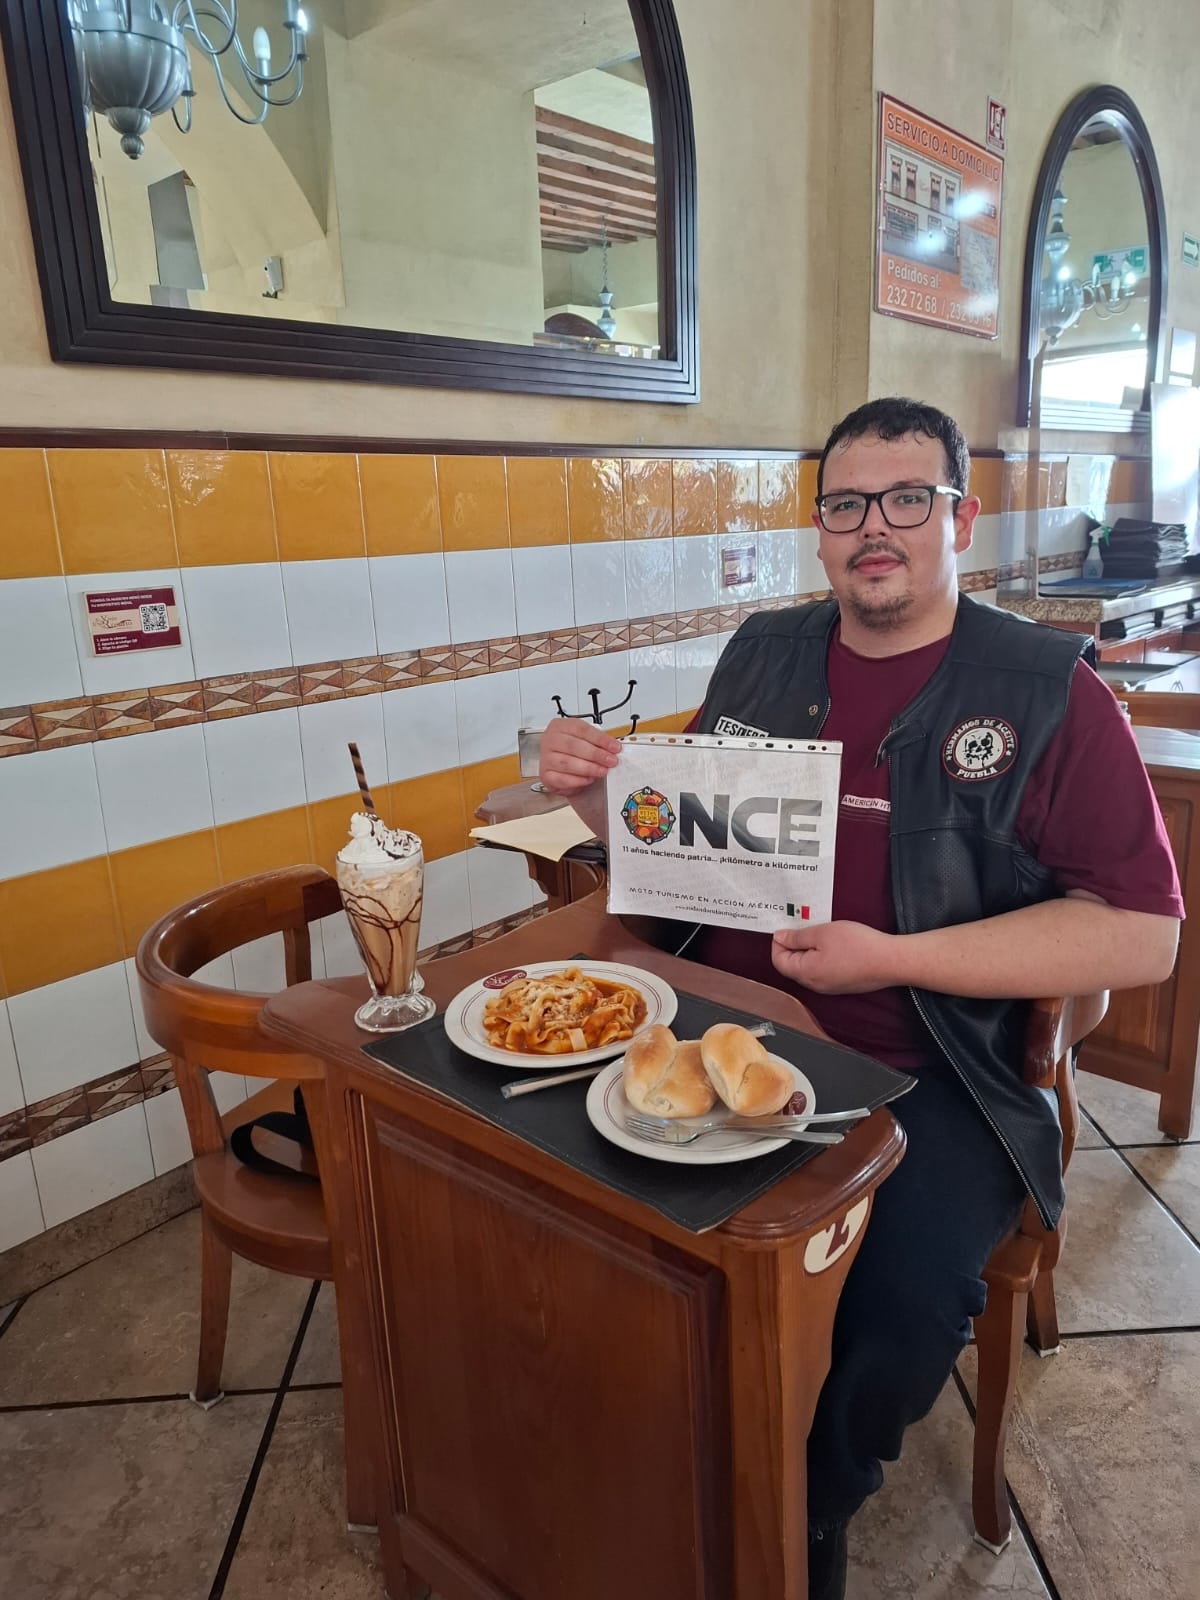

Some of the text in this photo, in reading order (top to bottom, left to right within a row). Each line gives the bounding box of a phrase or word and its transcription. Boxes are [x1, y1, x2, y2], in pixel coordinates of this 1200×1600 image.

[887, 112, 999, 182] SERVICIO A DOMICILIO
[887, 258, 929, 286] Pedidos
[983, 719, 996, 727] DE
[957, 766, 998, 779] PUEBLA
[622, 845, 629, 853] 11
[630, 845, 649, 855] años
[650, 849, 686, 860] haciendo
[772, 861, 818, 872] kilómetro!
[629, 887, 653, 895] MOTO
[656, 890, 695, 901] TURISMO
